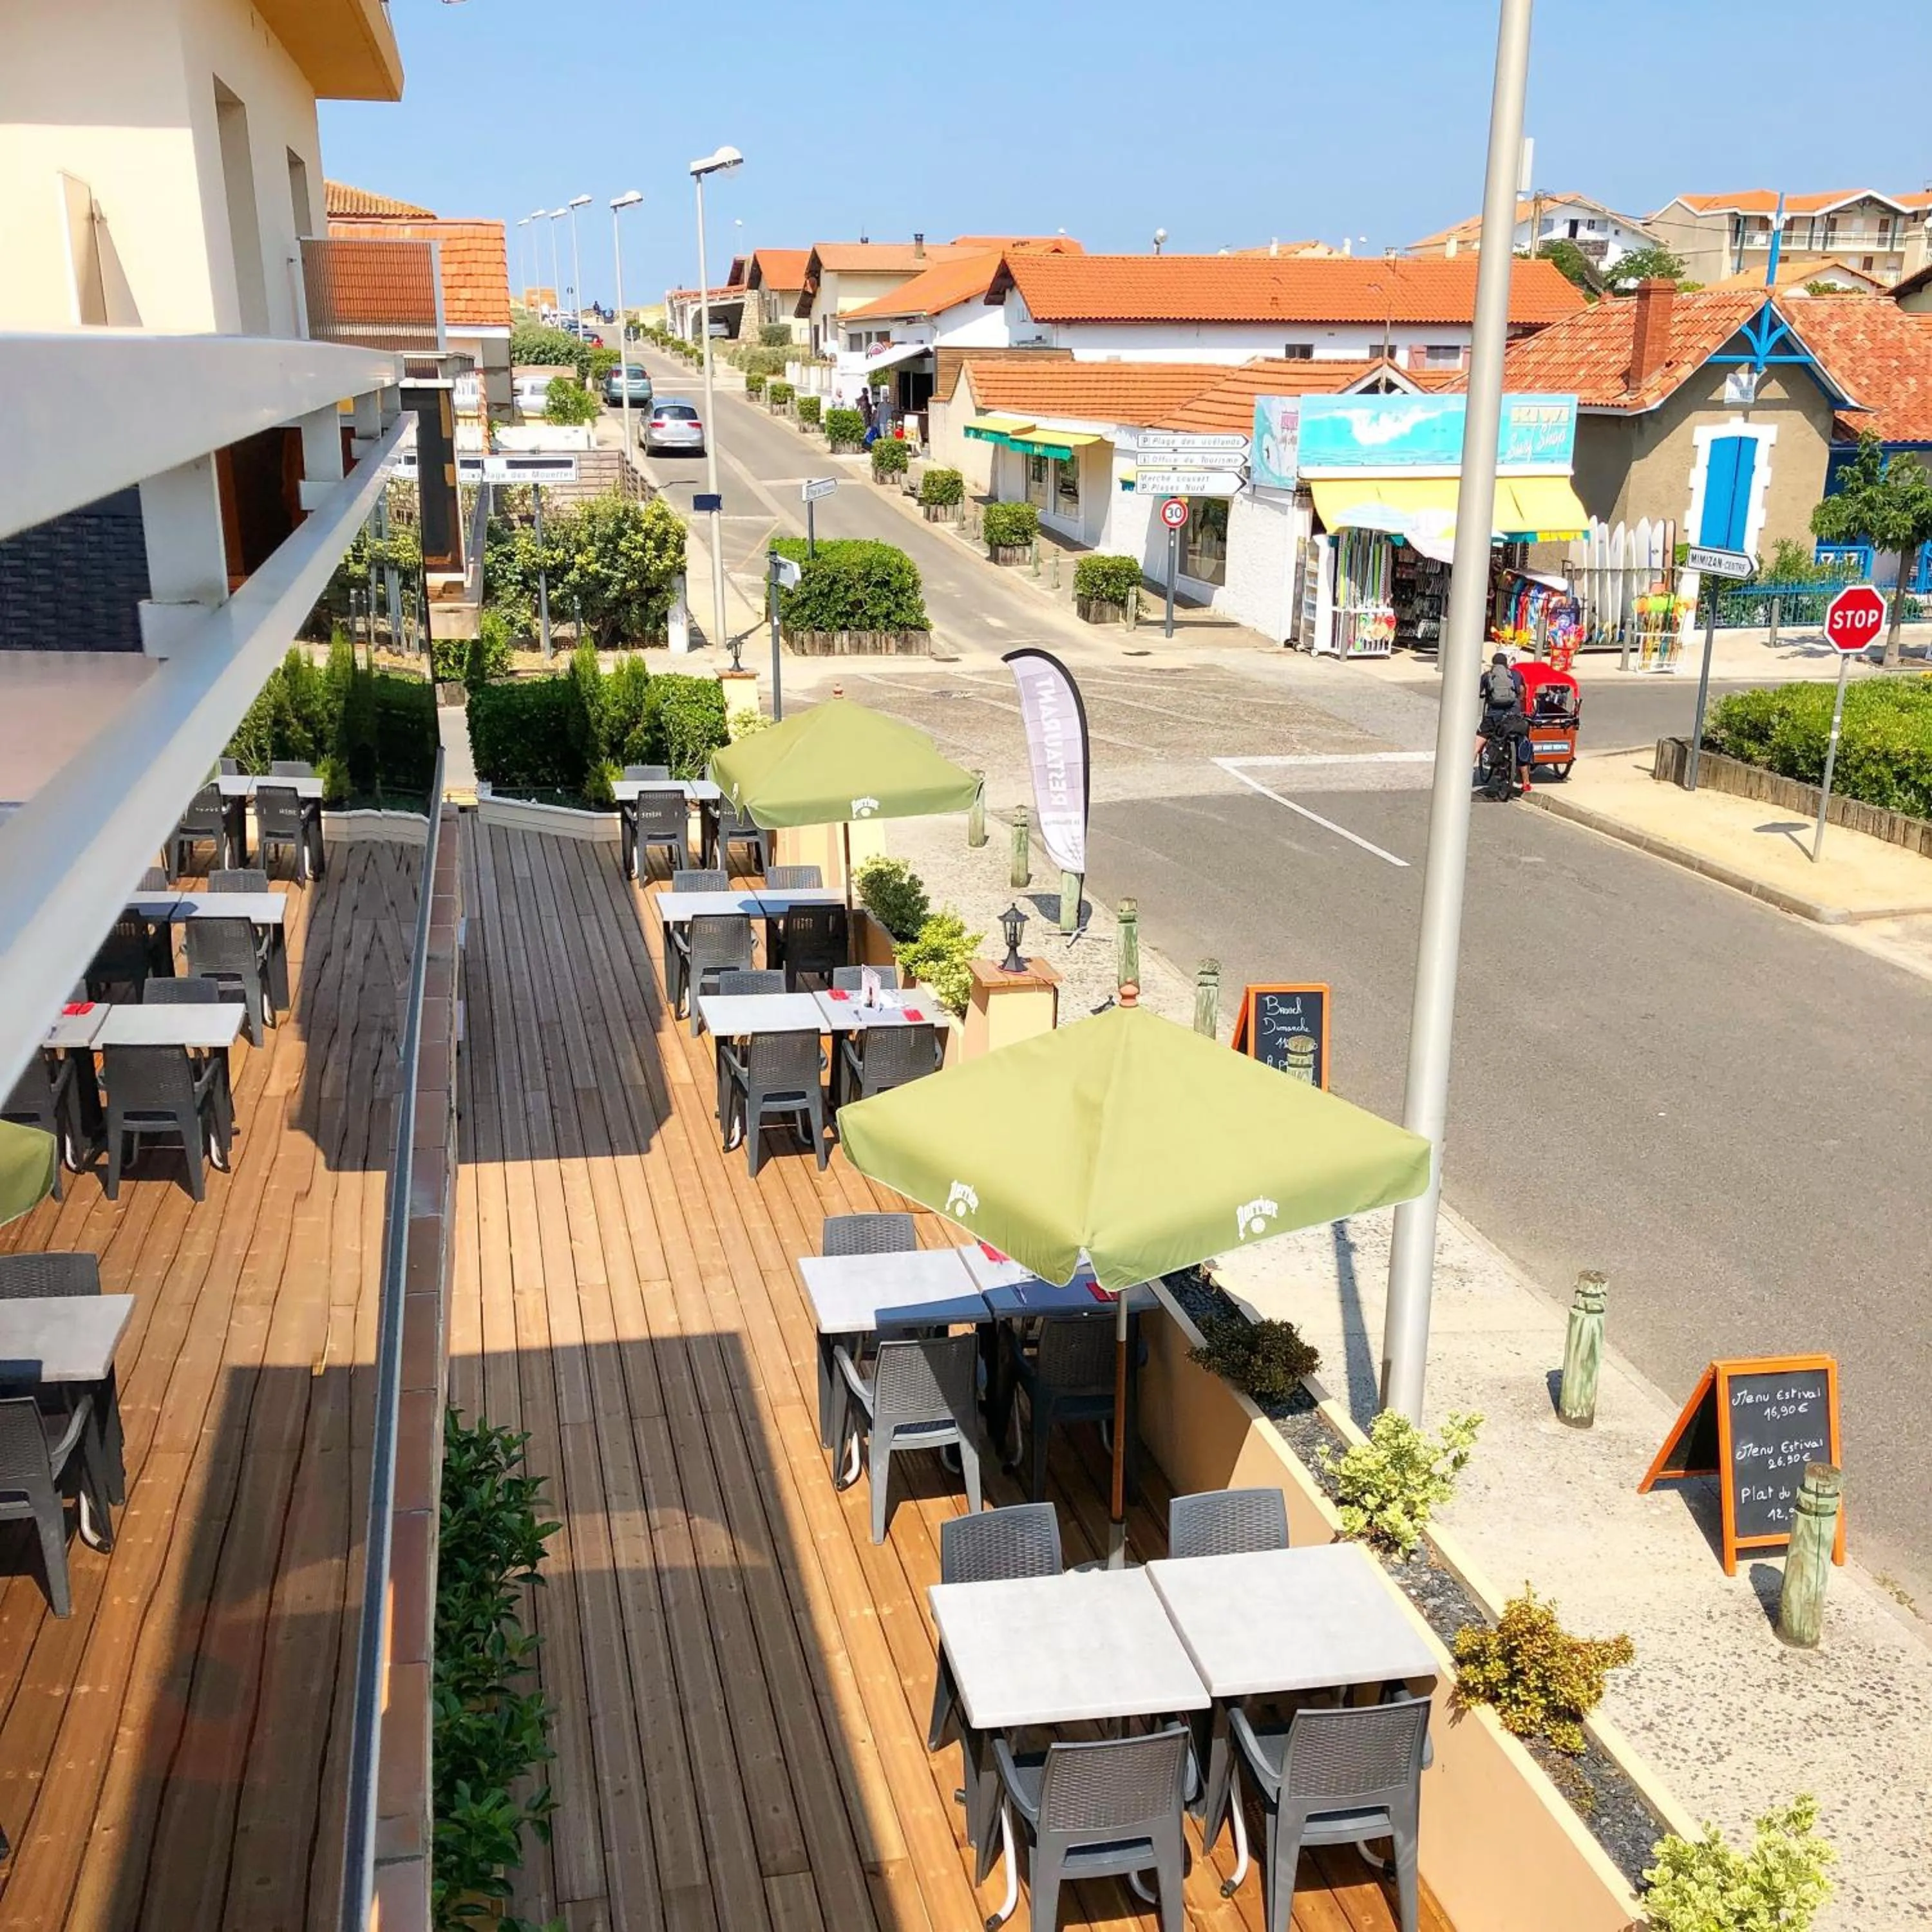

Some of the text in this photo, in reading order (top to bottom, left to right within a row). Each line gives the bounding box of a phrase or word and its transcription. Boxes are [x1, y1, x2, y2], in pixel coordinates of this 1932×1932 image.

[1151, 437, 1175, 446] Plage
[511, 470, 527, 478] des
[532, 470, 573, 478] Mouettes
[1166, 506, 1182, 519] 30
[1832, 609, 1879, 629] STOP
[1262, 1018, 1311, 1035] Dimanche
[1732, 1387, 1821, 1406] Menu Estival
[1736, 1438, 1823, 1460] Menu Estival
[1741, 1485, 1791, 1504] Plat du
